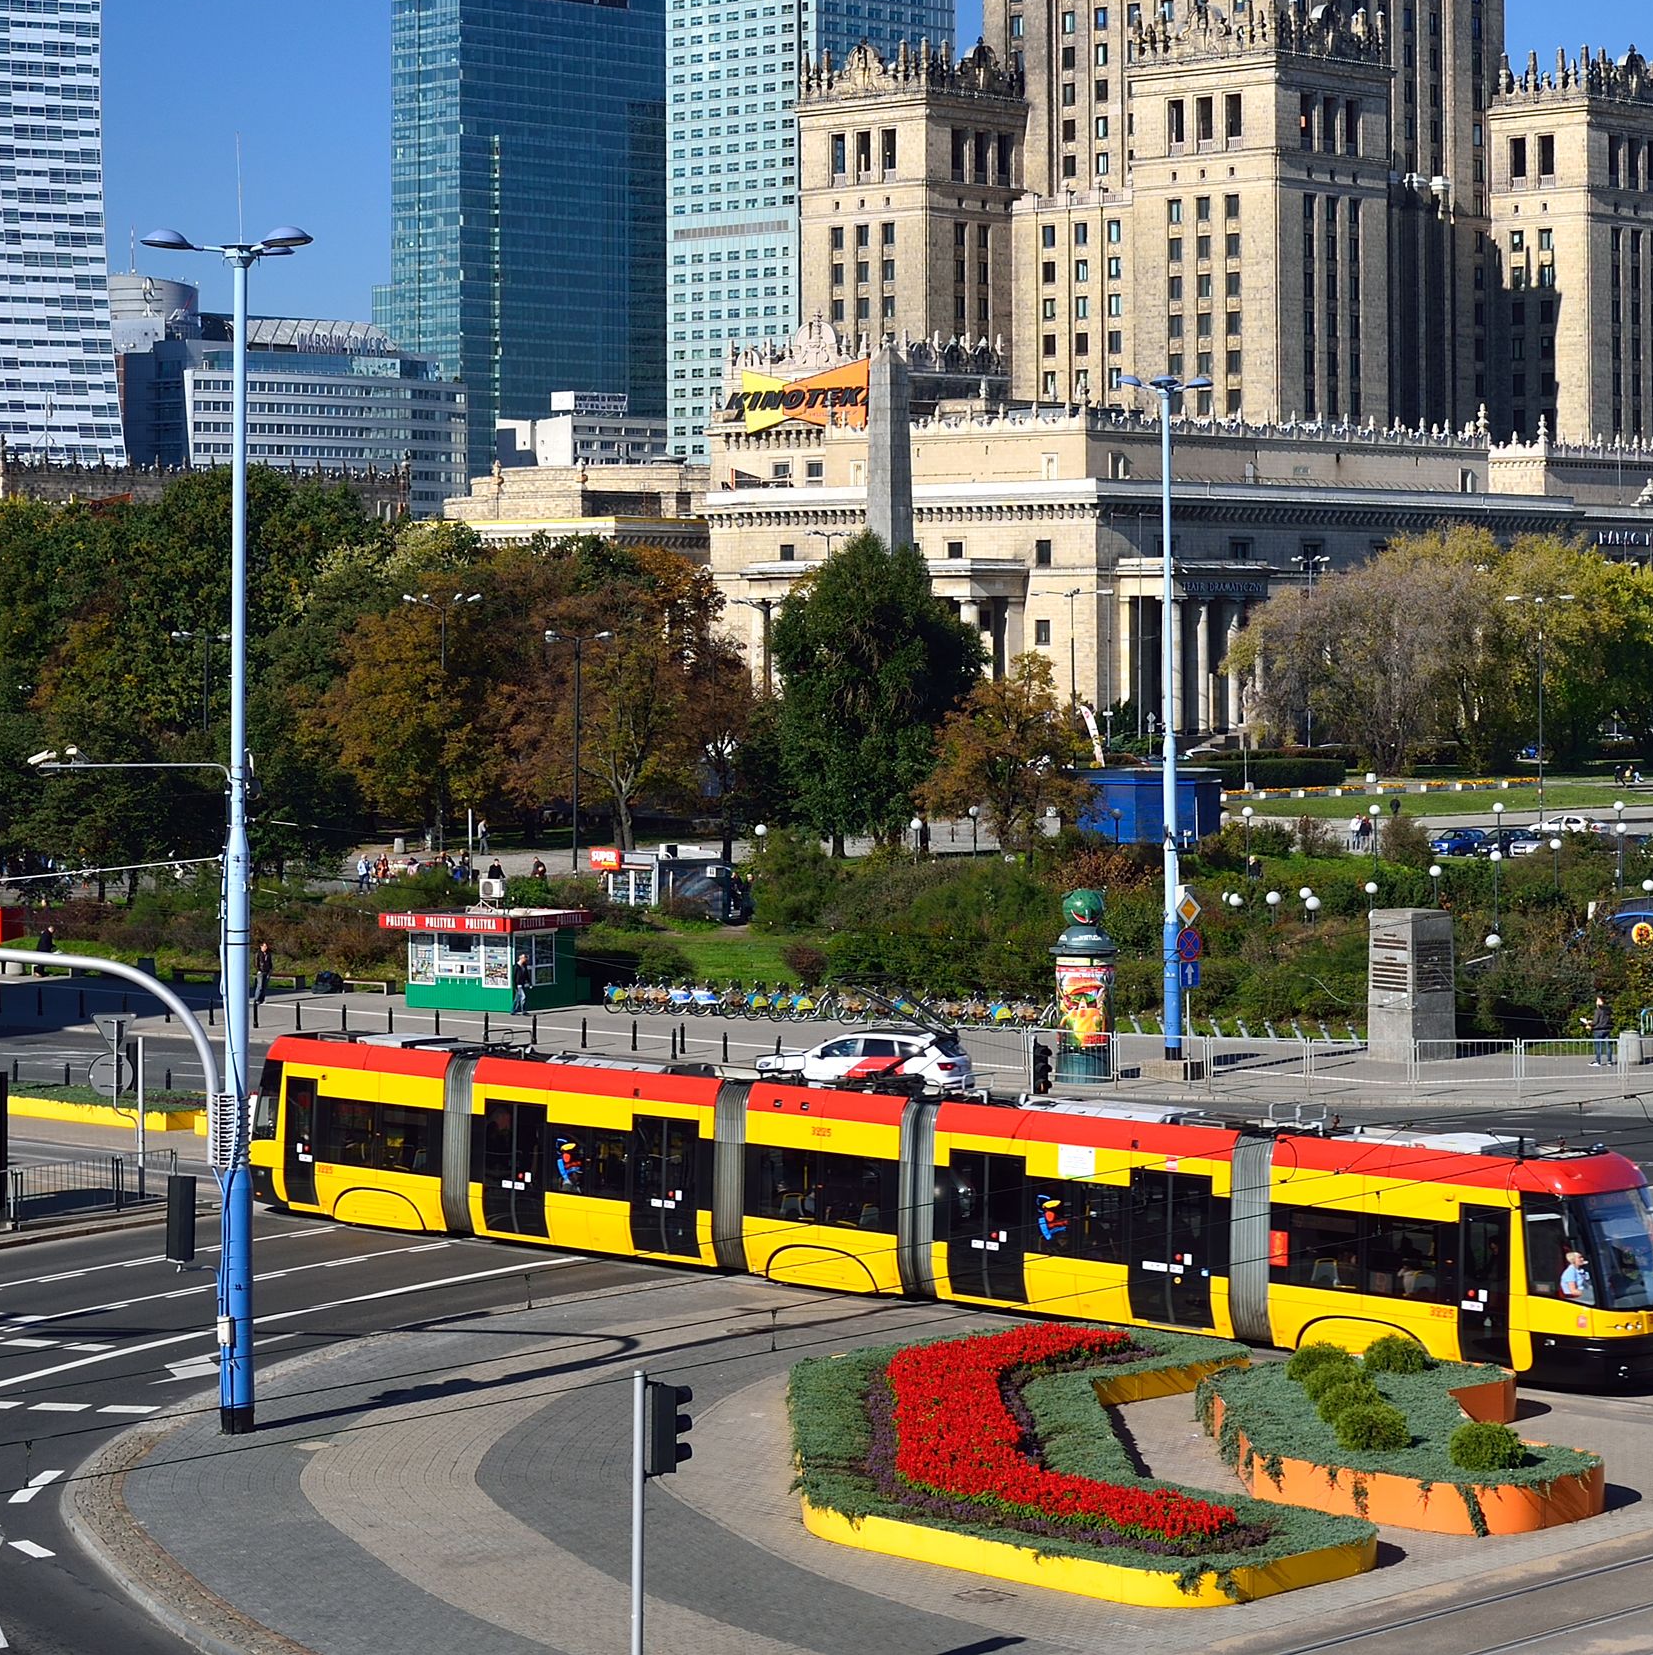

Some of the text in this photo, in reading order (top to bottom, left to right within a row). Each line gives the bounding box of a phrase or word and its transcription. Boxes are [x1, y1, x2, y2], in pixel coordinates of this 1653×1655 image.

[297, 332, 345, 354] WARSAW
[1182, 582, 1263, 593] TEATR DRAMATYCZNY
[591, 850, 616, 862] SUPER
[385, 915, 497, 930] POLITYKA POLITYKA POLITYKA
[519, 916, 546, 929] POLITYKA
